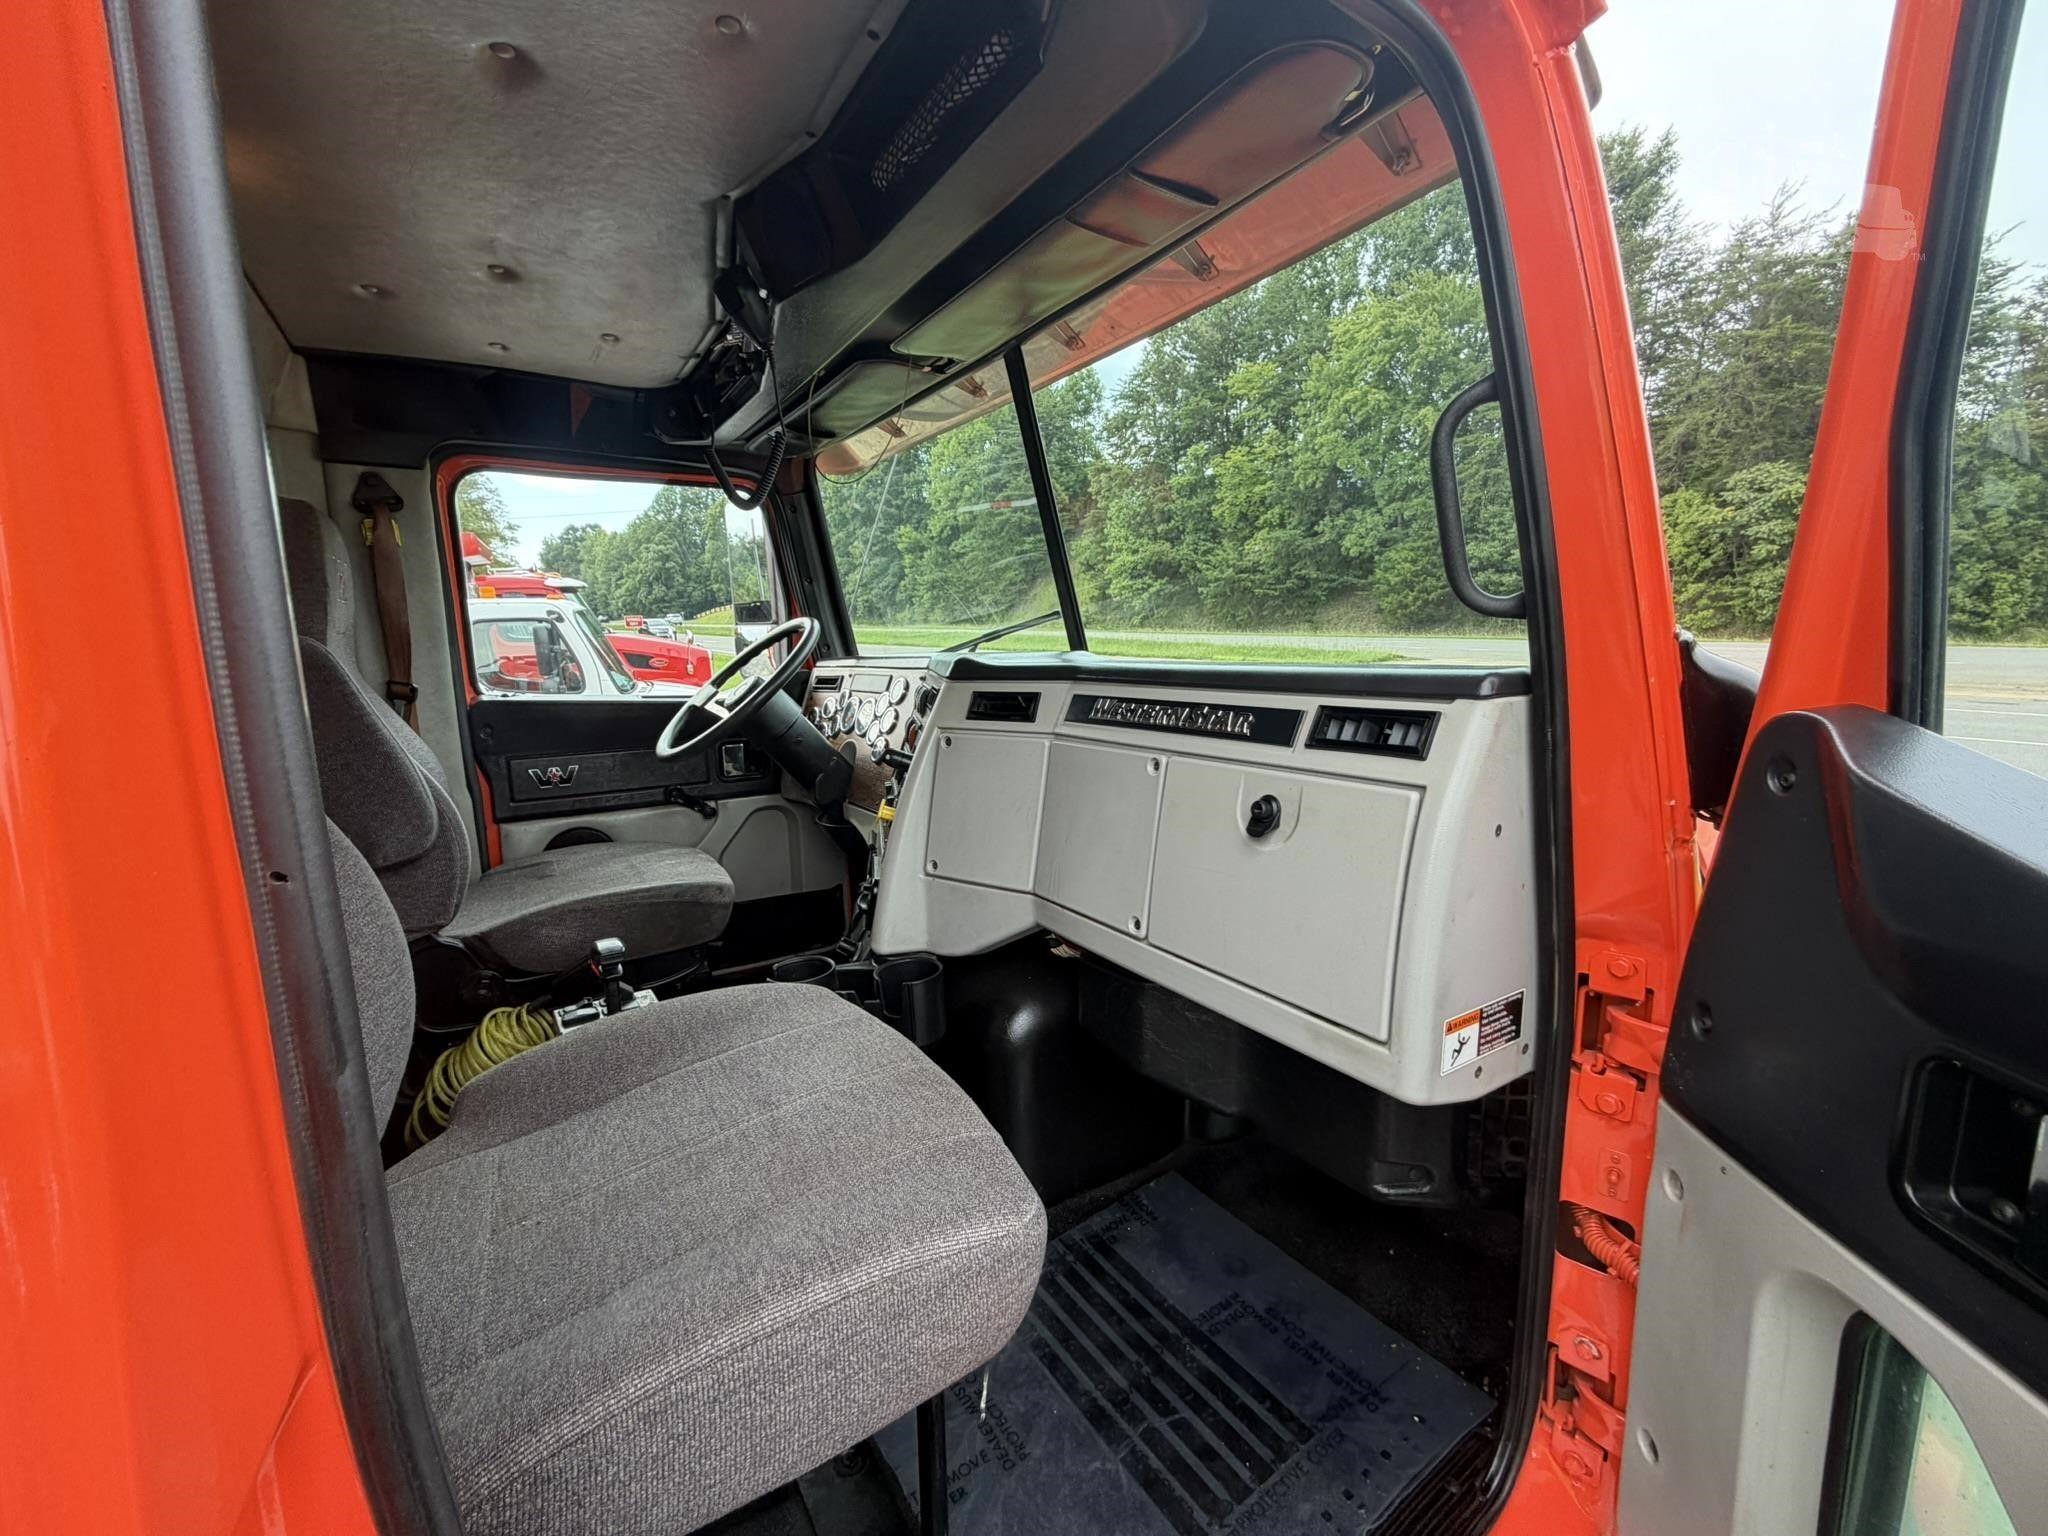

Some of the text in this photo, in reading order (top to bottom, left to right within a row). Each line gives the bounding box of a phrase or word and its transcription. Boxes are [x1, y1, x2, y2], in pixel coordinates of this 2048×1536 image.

[1088, 698, 1254, 737] WESTERN STAR
[1453, 1012, 1479, 1030] WARNING
[948, 1382, 1017, 1472] DEALER MUST
